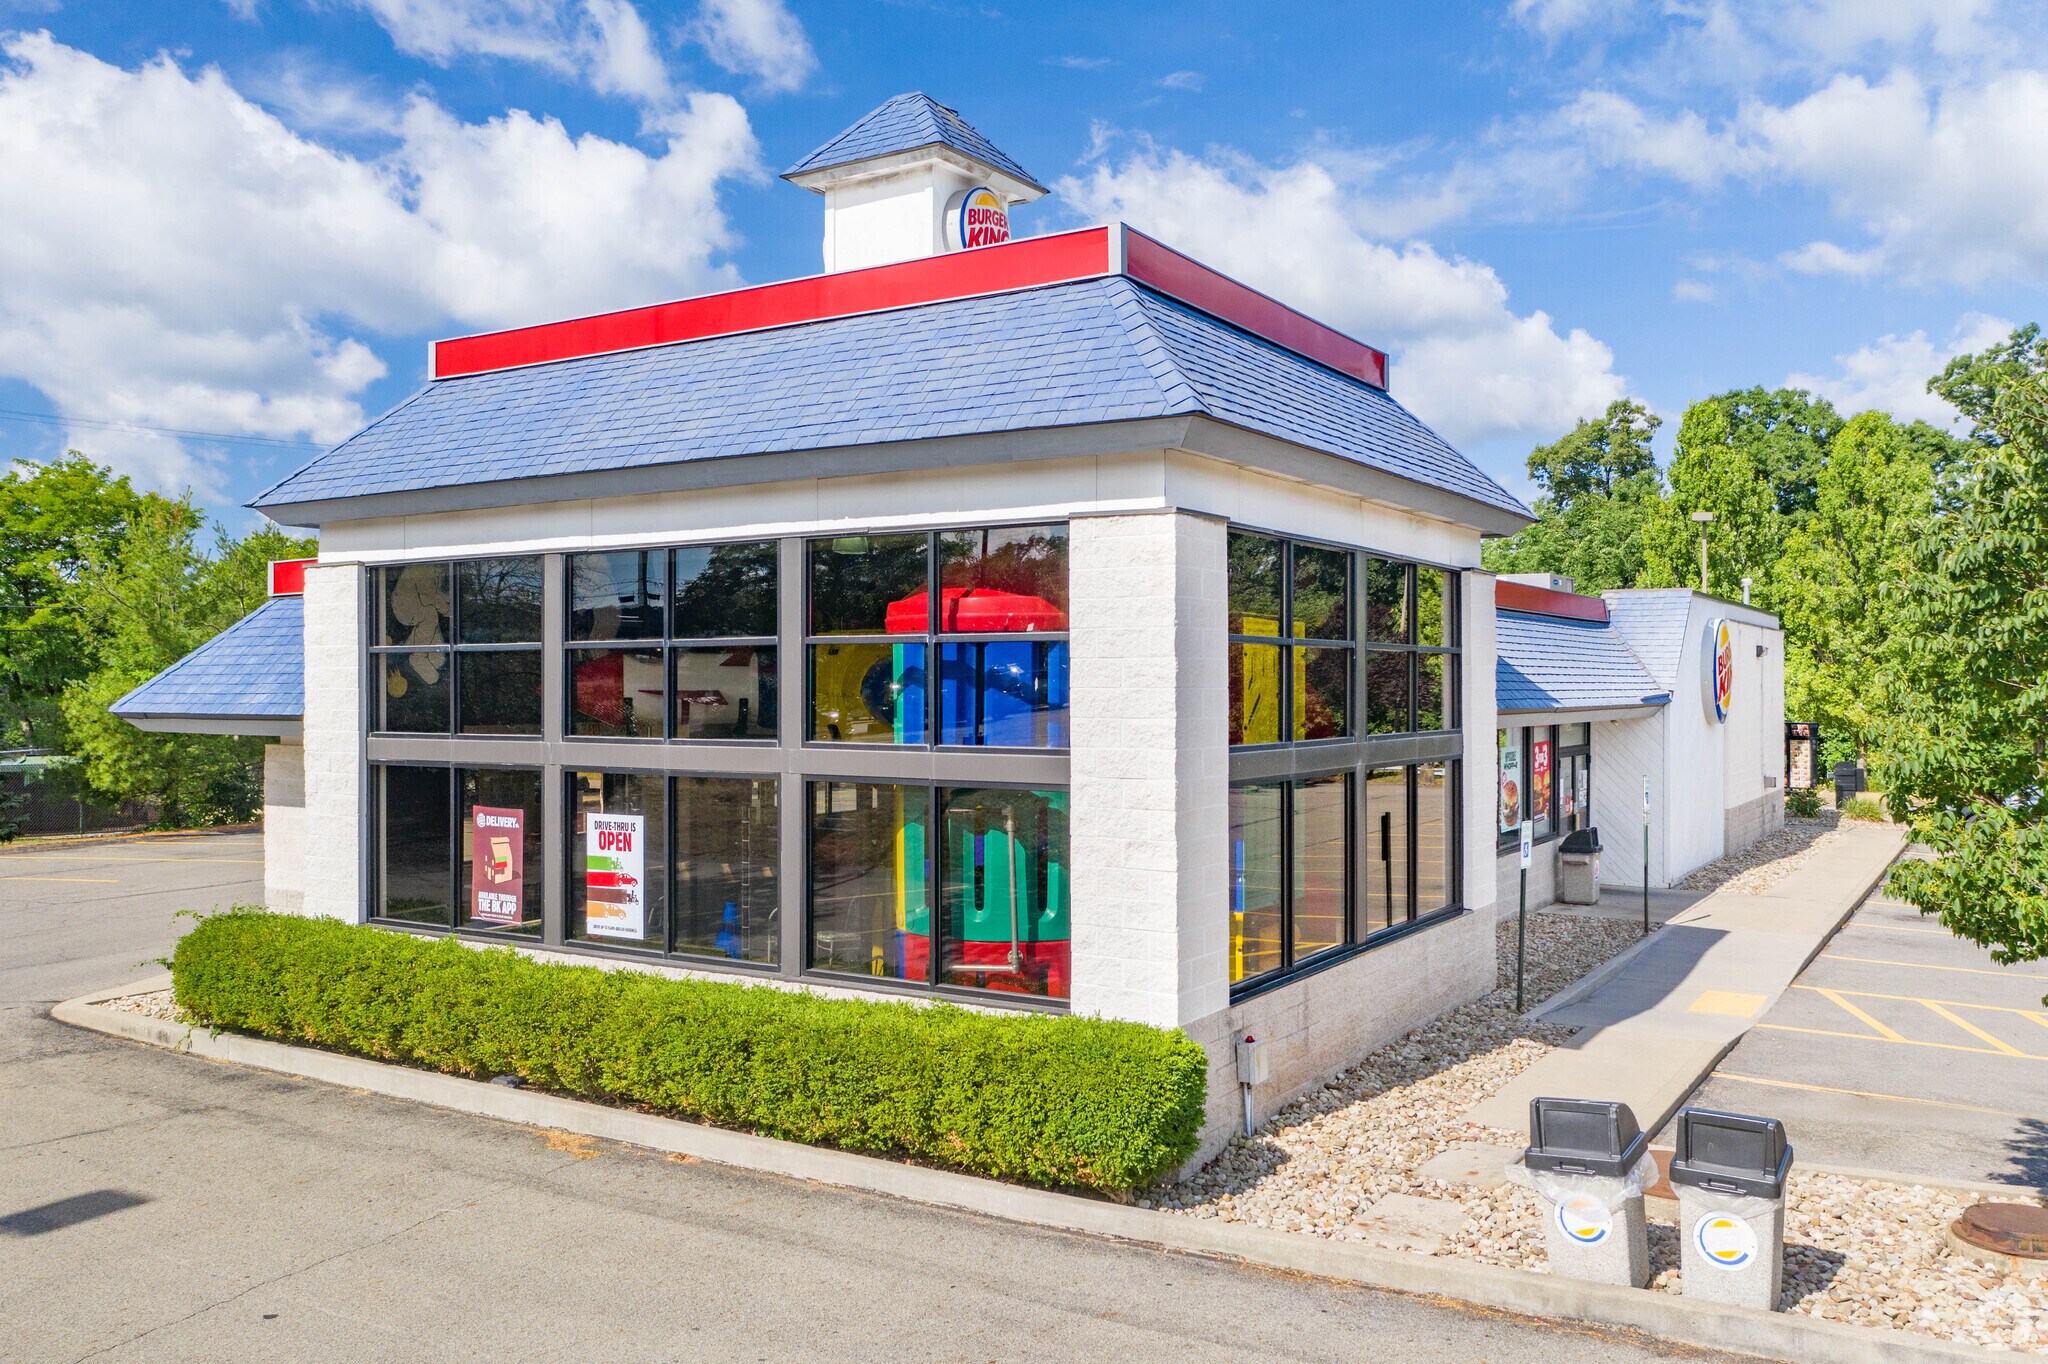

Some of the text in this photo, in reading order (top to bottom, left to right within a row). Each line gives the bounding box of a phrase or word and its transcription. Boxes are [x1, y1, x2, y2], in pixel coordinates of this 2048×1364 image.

[594, 820, 636, 832] DRIVE-THRU IS
[599, 831, 632, 852] OPEN
[478, 898, 517, 915] THE BK APP
